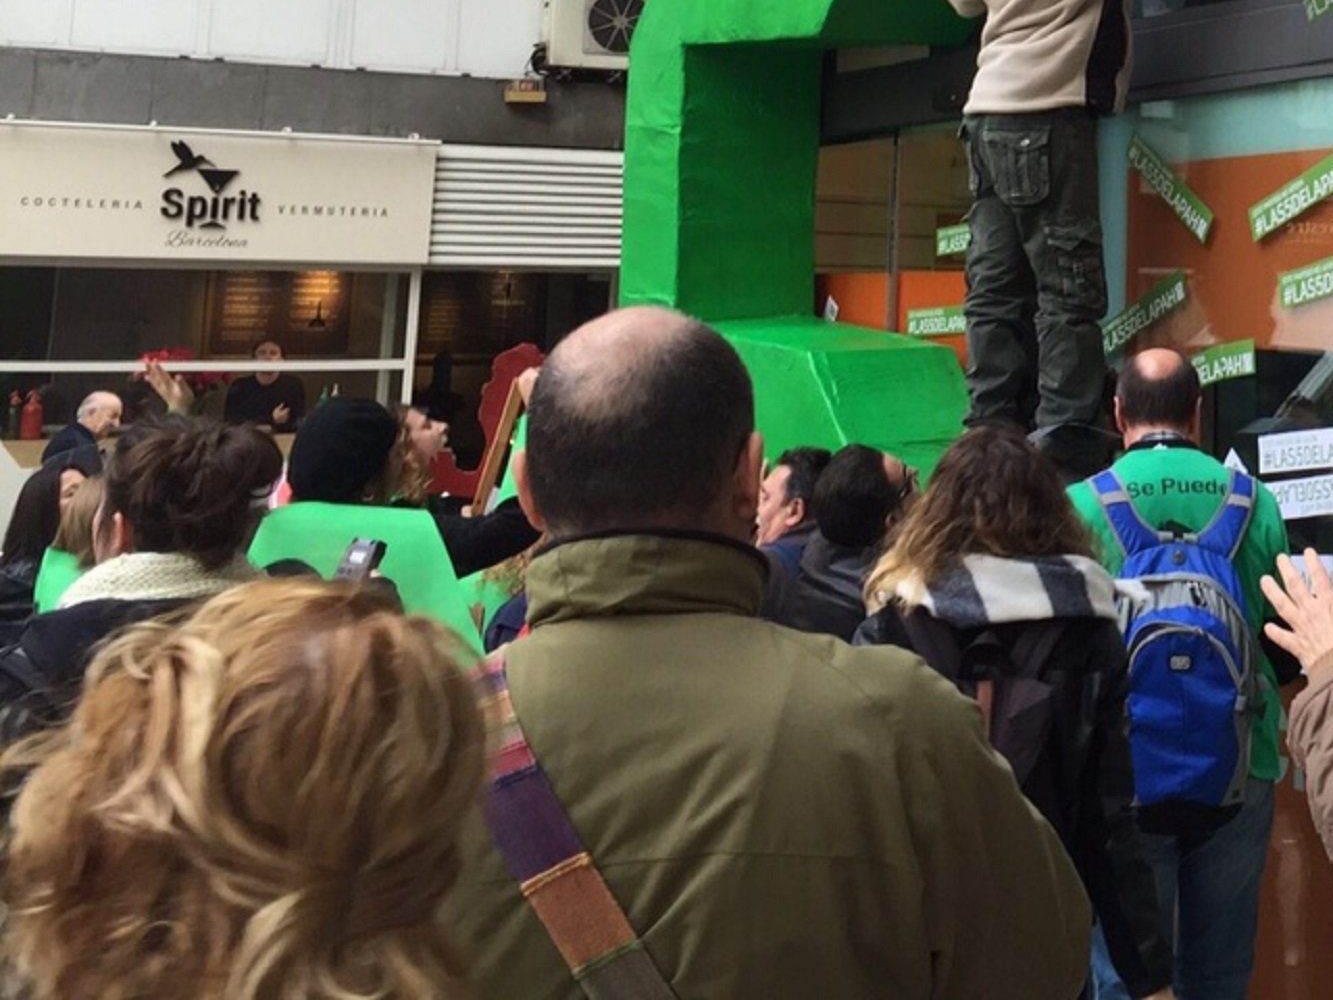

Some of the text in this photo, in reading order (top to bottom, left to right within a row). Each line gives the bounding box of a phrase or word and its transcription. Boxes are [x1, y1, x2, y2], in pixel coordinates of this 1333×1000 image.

[20, 195, 144, 210] COCTELERIA
[160, 187, 262, 229] Spirit
[278, 204, 389, 219] VERMUTERIA
[165, 230, 249, 249] Barcelona
[1125, 481, 1154, 499] Se
